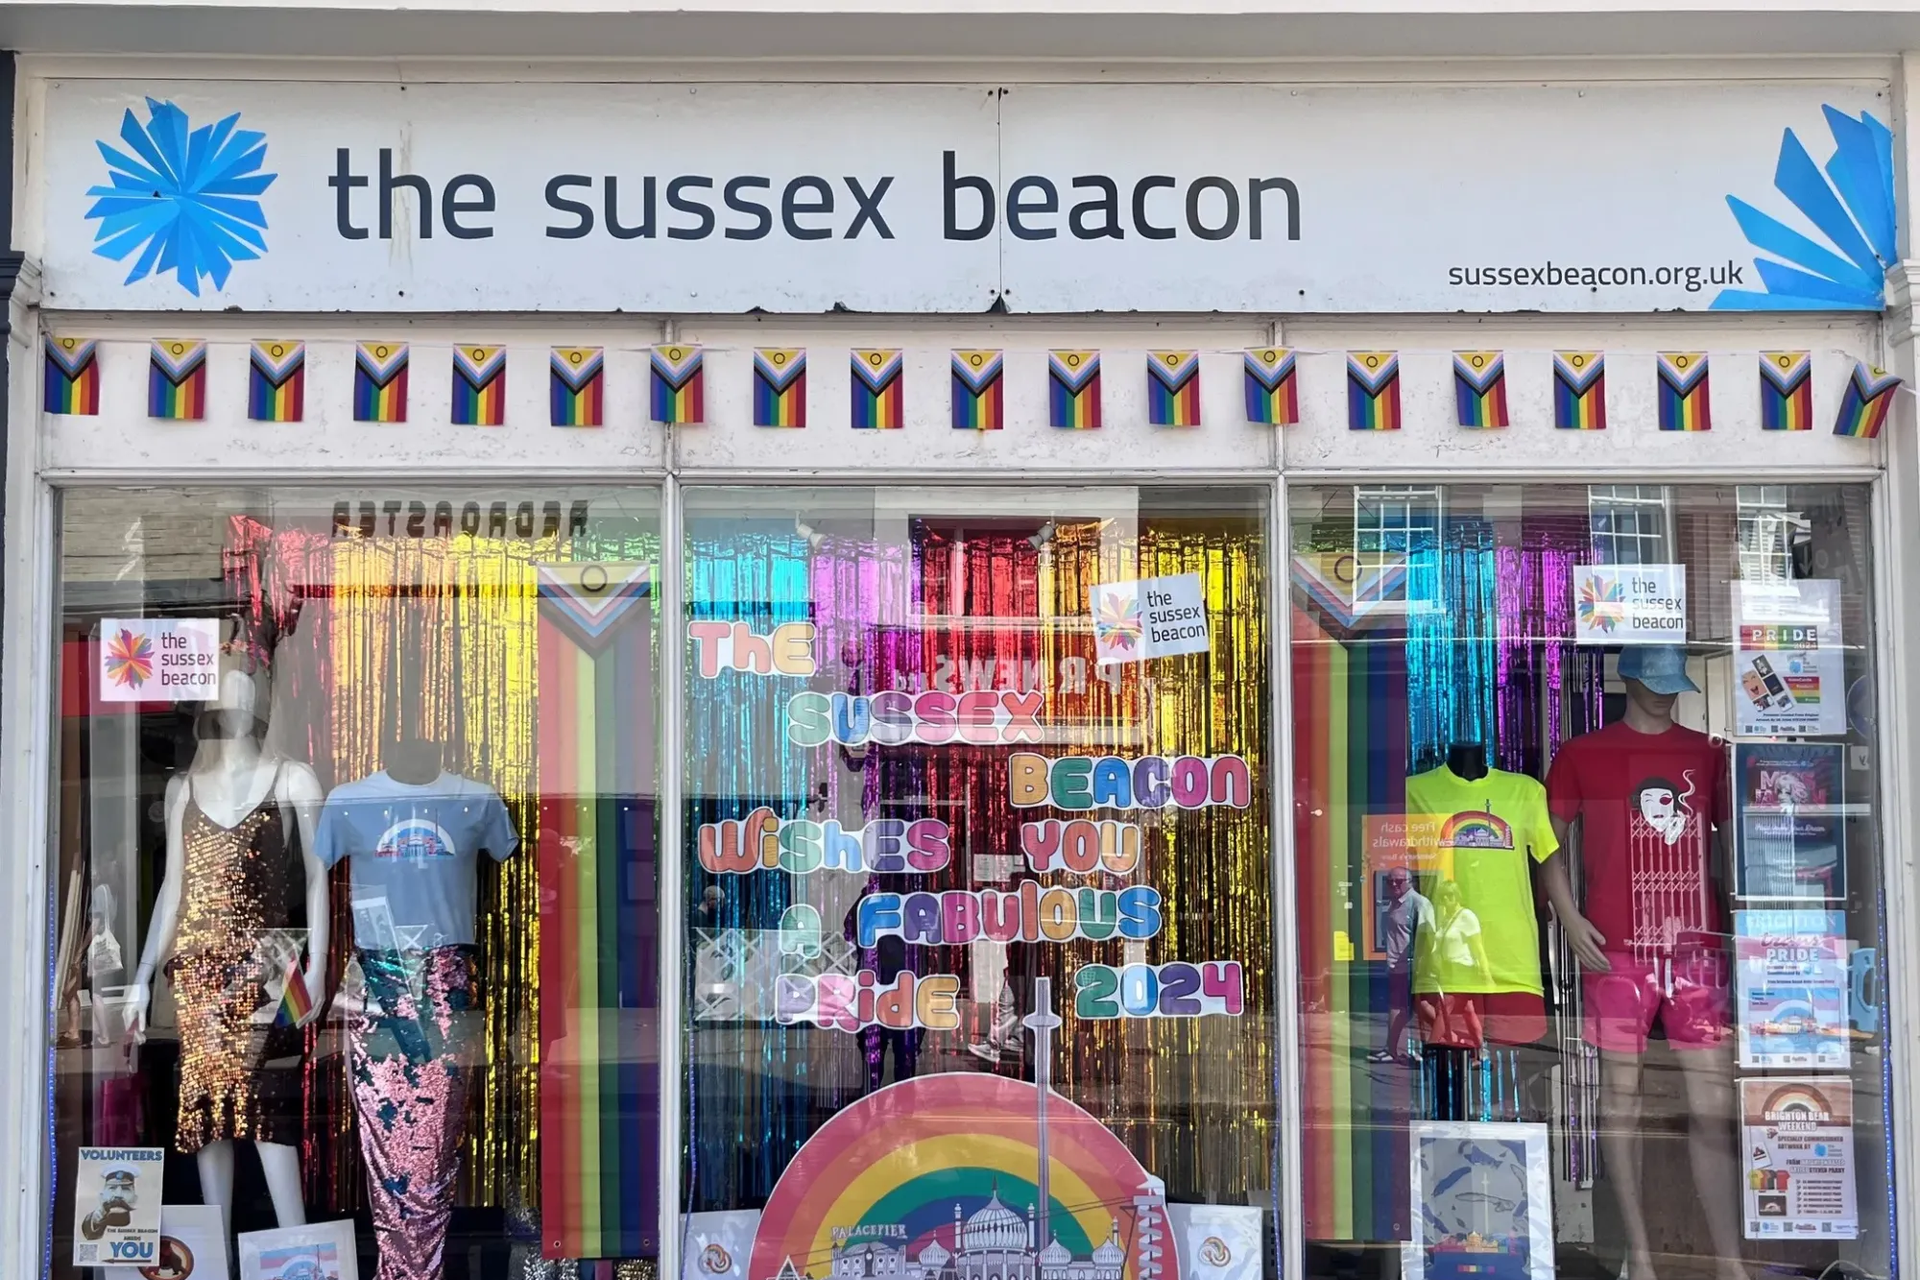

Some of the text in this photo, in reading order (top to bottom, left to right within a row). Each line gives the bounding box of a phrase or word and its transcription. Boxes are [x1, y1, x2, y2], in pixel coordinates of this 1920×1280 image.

[328, 148, 1301, 241] the sussex beacon
[1448, 260, 1744, 292] sussexbeacon.org.uk
[1632, 577, 1657, 596] the
[1146, 590, 1172, 607] the
[1632, 597, 1683, 612] sussex
[1148, 605, 1201, 624] sussex
[1632, 613, 1684, 630] beacon
[161, 632, 187, 649] the
[1151, 622, 1206, 644] beacon
[1752, 629, 1817, 642] PRIDE
[161, 651, 215, 667] sussex
[161, 668, 217, 687] beacon
[789, 692, 1042, 744] SUSSEX
[1022, 821, 1139, 873] YOU
[782, 906, 821, 956] A
[1766, 948, 1819, 962] PRIDE
[1075, 963, 1243, 1018] 2024
[1765, 1111, 1829, 1121] BRIGHTON BEAR
[1778, 1121, 1817, 1131] WEEKEND
[81, 1150, 163, 1161] VOLUNTEERS
[110, 1242, 153, 1258] YOU
